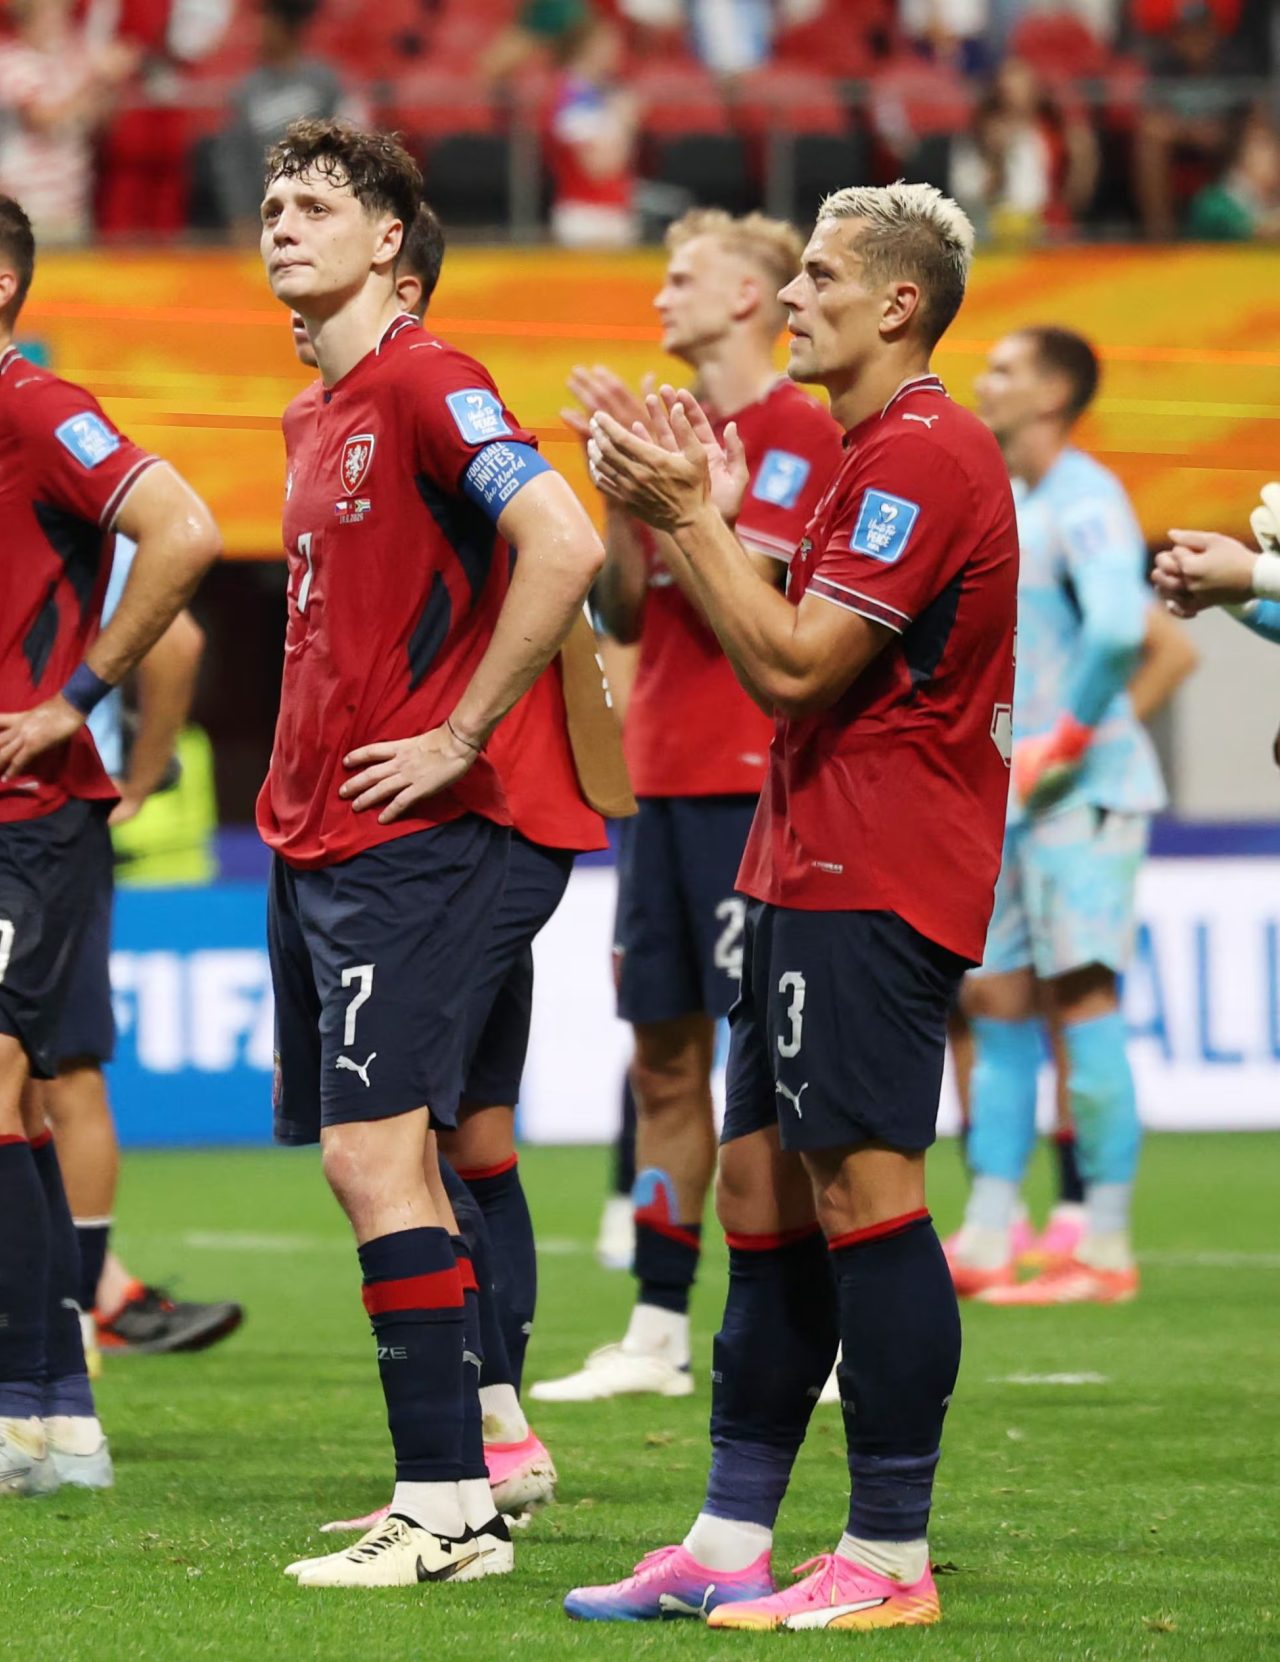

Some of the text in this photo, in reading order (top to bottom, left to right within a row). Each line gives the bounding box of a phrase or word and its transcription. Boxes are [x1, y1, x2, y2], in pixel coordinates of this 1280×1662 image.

[466, 442, 506, 481] FOOTBALL
[473, 447, 515, 492] UNITES
[484, 456, 527, 504] the World
[499, 478, 519, 501] FIFA
[297, 531, 313, 614] 7
[341, 963, 376, 1046] 7
[777, 970, 806, 1058] 3
